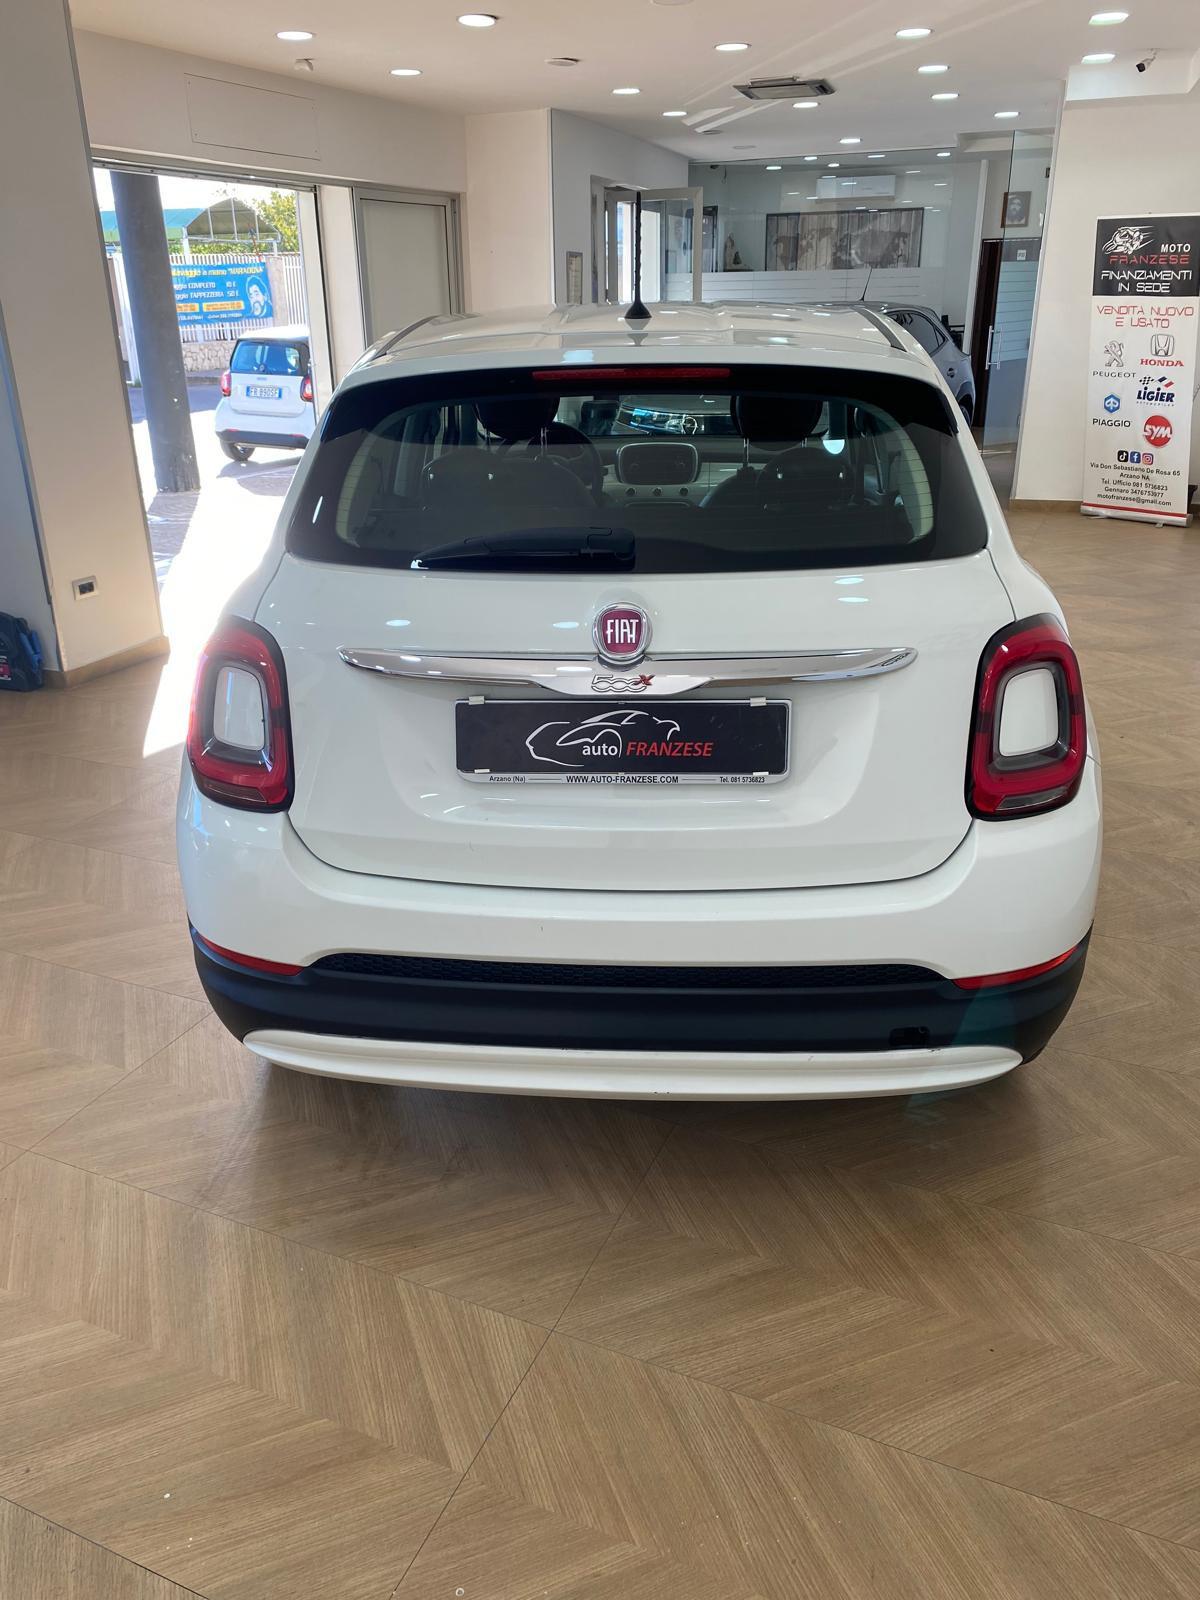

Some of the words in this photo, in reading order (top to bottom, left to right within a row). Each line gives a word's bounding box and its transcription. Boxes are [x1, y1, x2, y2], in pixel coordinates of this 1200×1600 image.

[1160, 243, 1191, 252] MOTO
[1109, 254, 1190, 264] FRANZESE
[1100, 270, 1192, 280] FINANZIAMENTI
[1118, 282, 1130, 292] IN
[1136, 282, 1171, 293] SEDE
[1097, 305, 1145, 315] VENDITA
[1150, 306, 1194, 316] NUOVO
[1115, 317, 1124, 327] E
[1130, 318, 1170, 329] USATO
[1140, 358, 1185, 367] HONDA
[1092, 370, 1137, 378] PEUGEOT
[1092, 418, 1131, 428] PIAGGIO
[1143, 424, 1173, 440] SYM
[1100, 462, 1112, 470] Don
[1113, 464, 1145, 472] Sebastiano
[1156, 468, 1171, 476] Rosa
[1119, 472, 1140, 480] Arzano
[1112, 479, 1132, 487] Ufficio
[1104, 486, 1130, 494] Gennaro
[1097, 493, 1172, 506] motofranzese@gmail.com
[606, 619, 639, 644] FIAT
[582, 743, 618, 756] auto
[626, 741, 714, 757] FRANZESE
[512, 775, 526, 784] (Na)
[566, 775, 679, 784] WWW.AUTO-FRANZESE.COM
[742, 776, 765, 784] 5736823
